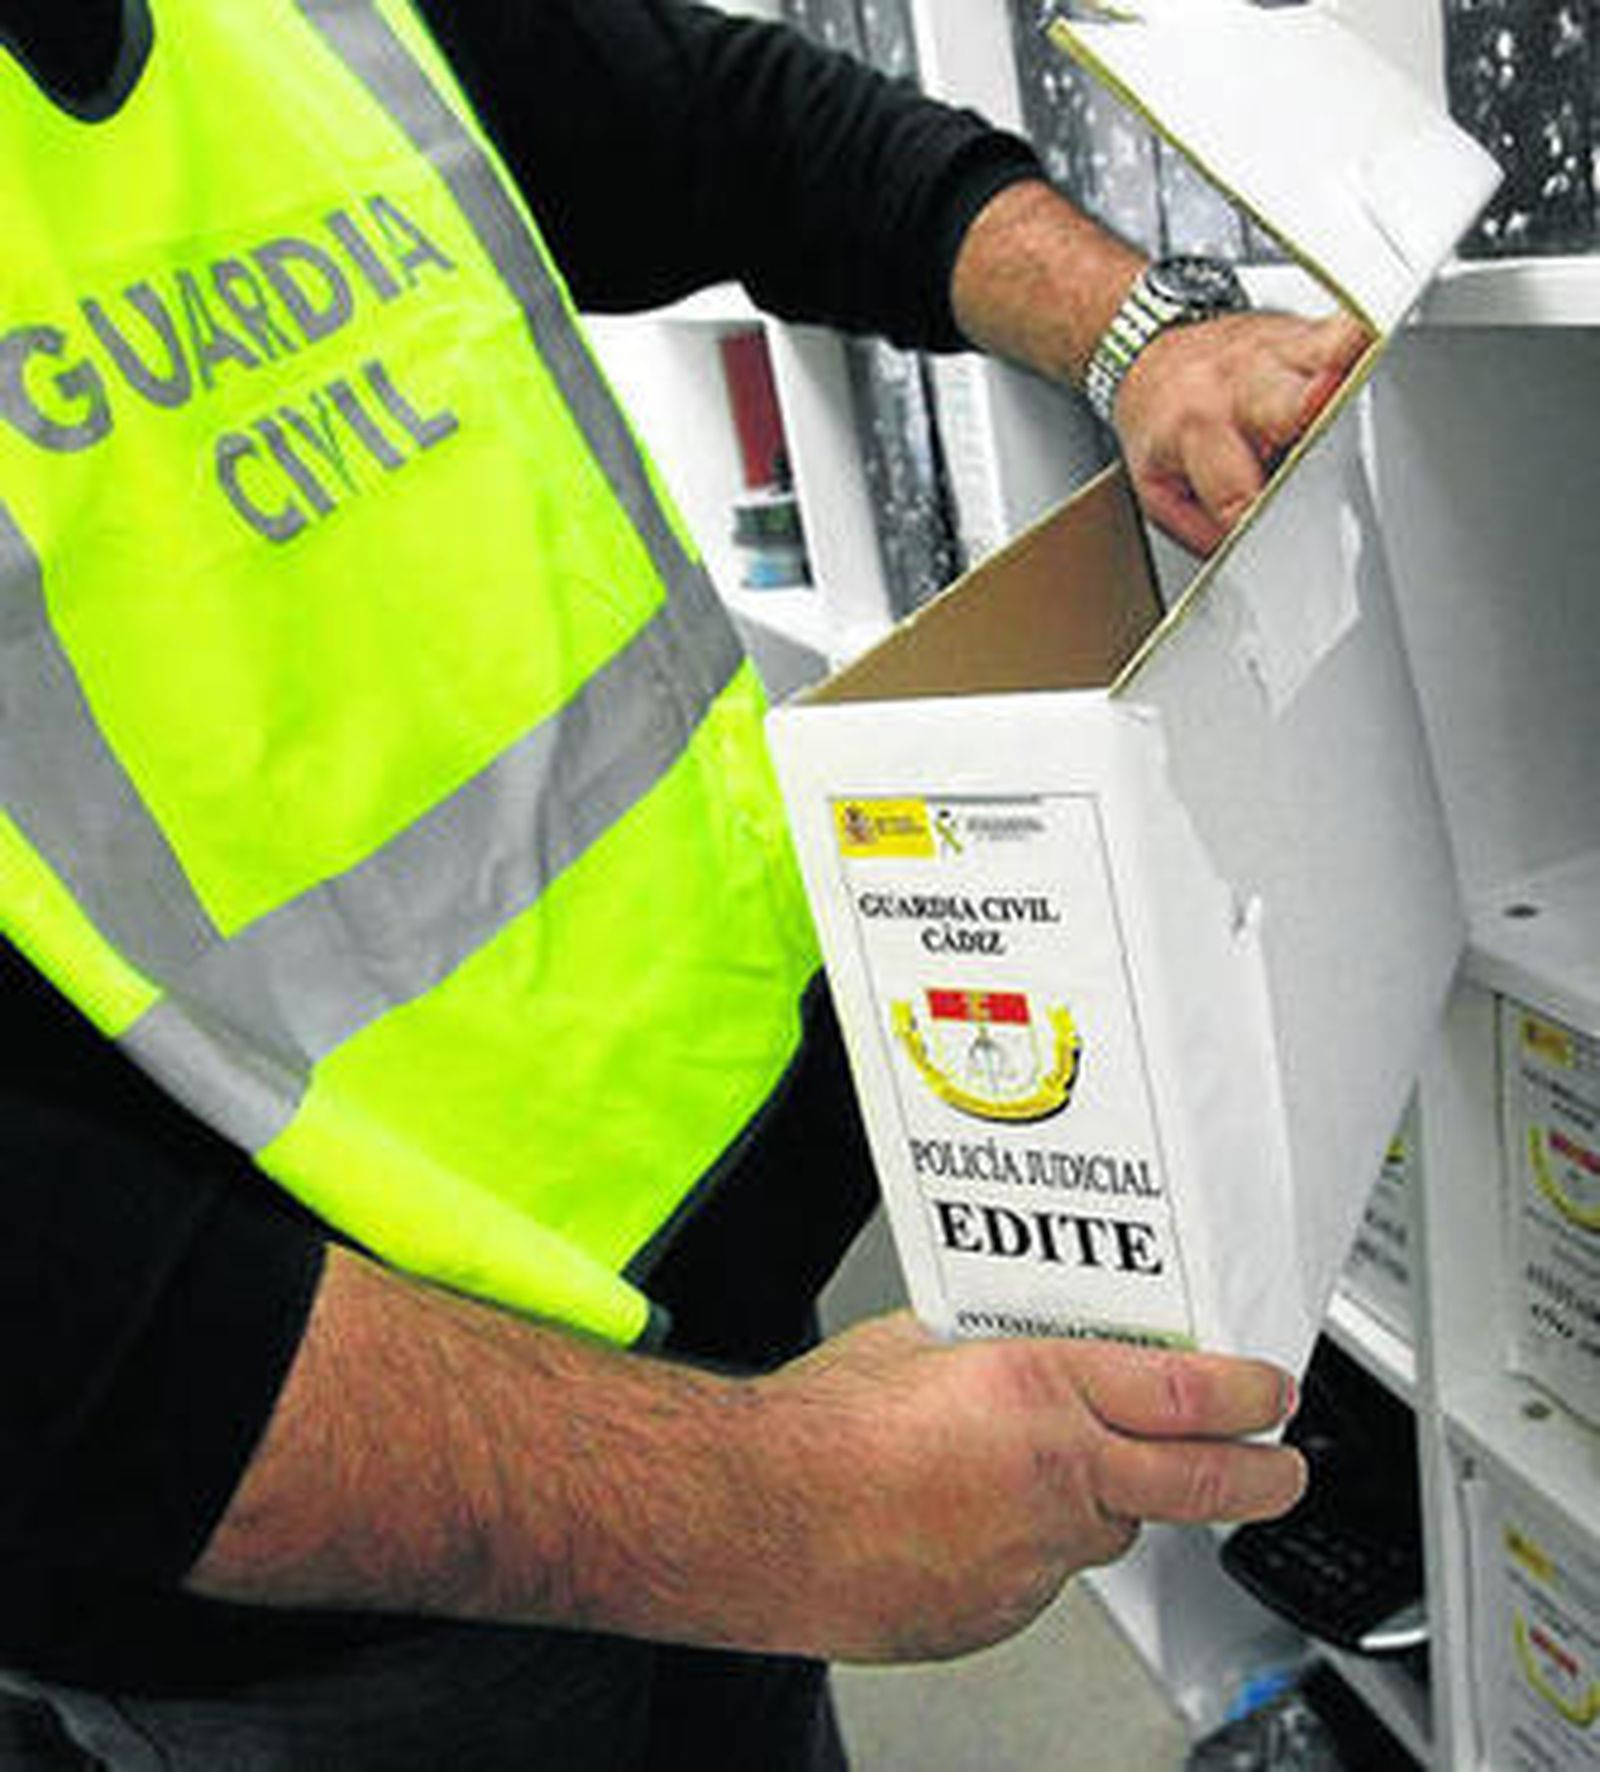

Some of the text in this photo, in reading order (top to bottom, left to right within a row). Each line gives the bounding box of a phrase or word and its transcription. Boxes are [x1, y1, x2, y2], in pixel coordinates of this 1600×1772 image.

[0, 194, 456, 453] GUARDIA
[215, 360, 460, 544] CIVIL
[858, 892, 1060, 922] GUARDIA CIVIL
[908, 1136, 1162, 1197] POLICÍA JUDICIAL
[936, 1201, 1163, 1276] EDITE
